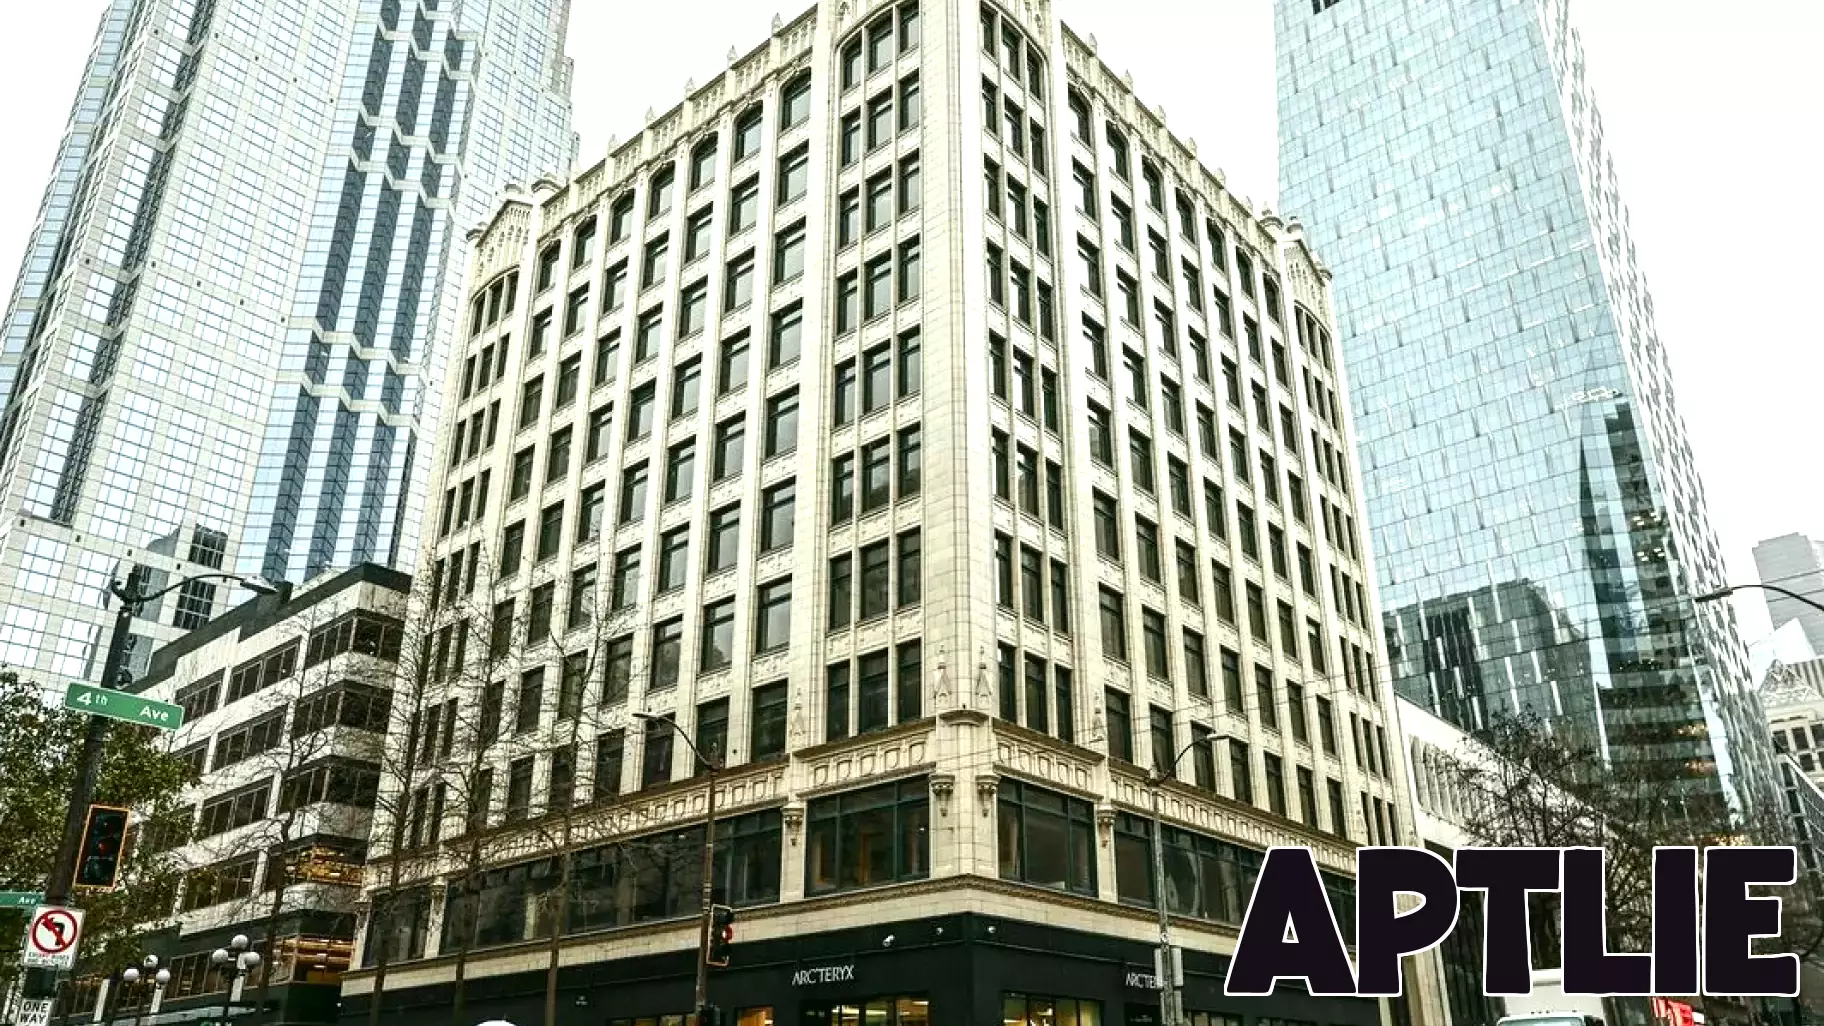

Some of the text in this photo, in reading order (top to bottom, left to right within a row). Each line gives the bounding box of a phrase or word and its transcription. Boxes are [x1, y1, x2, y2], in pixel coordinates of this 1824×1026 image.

[77, 692, 169, 721] 4th Ave
[23, 1001, 49, 1012] ONE
[20, 1013, 46, 1024] WAY
